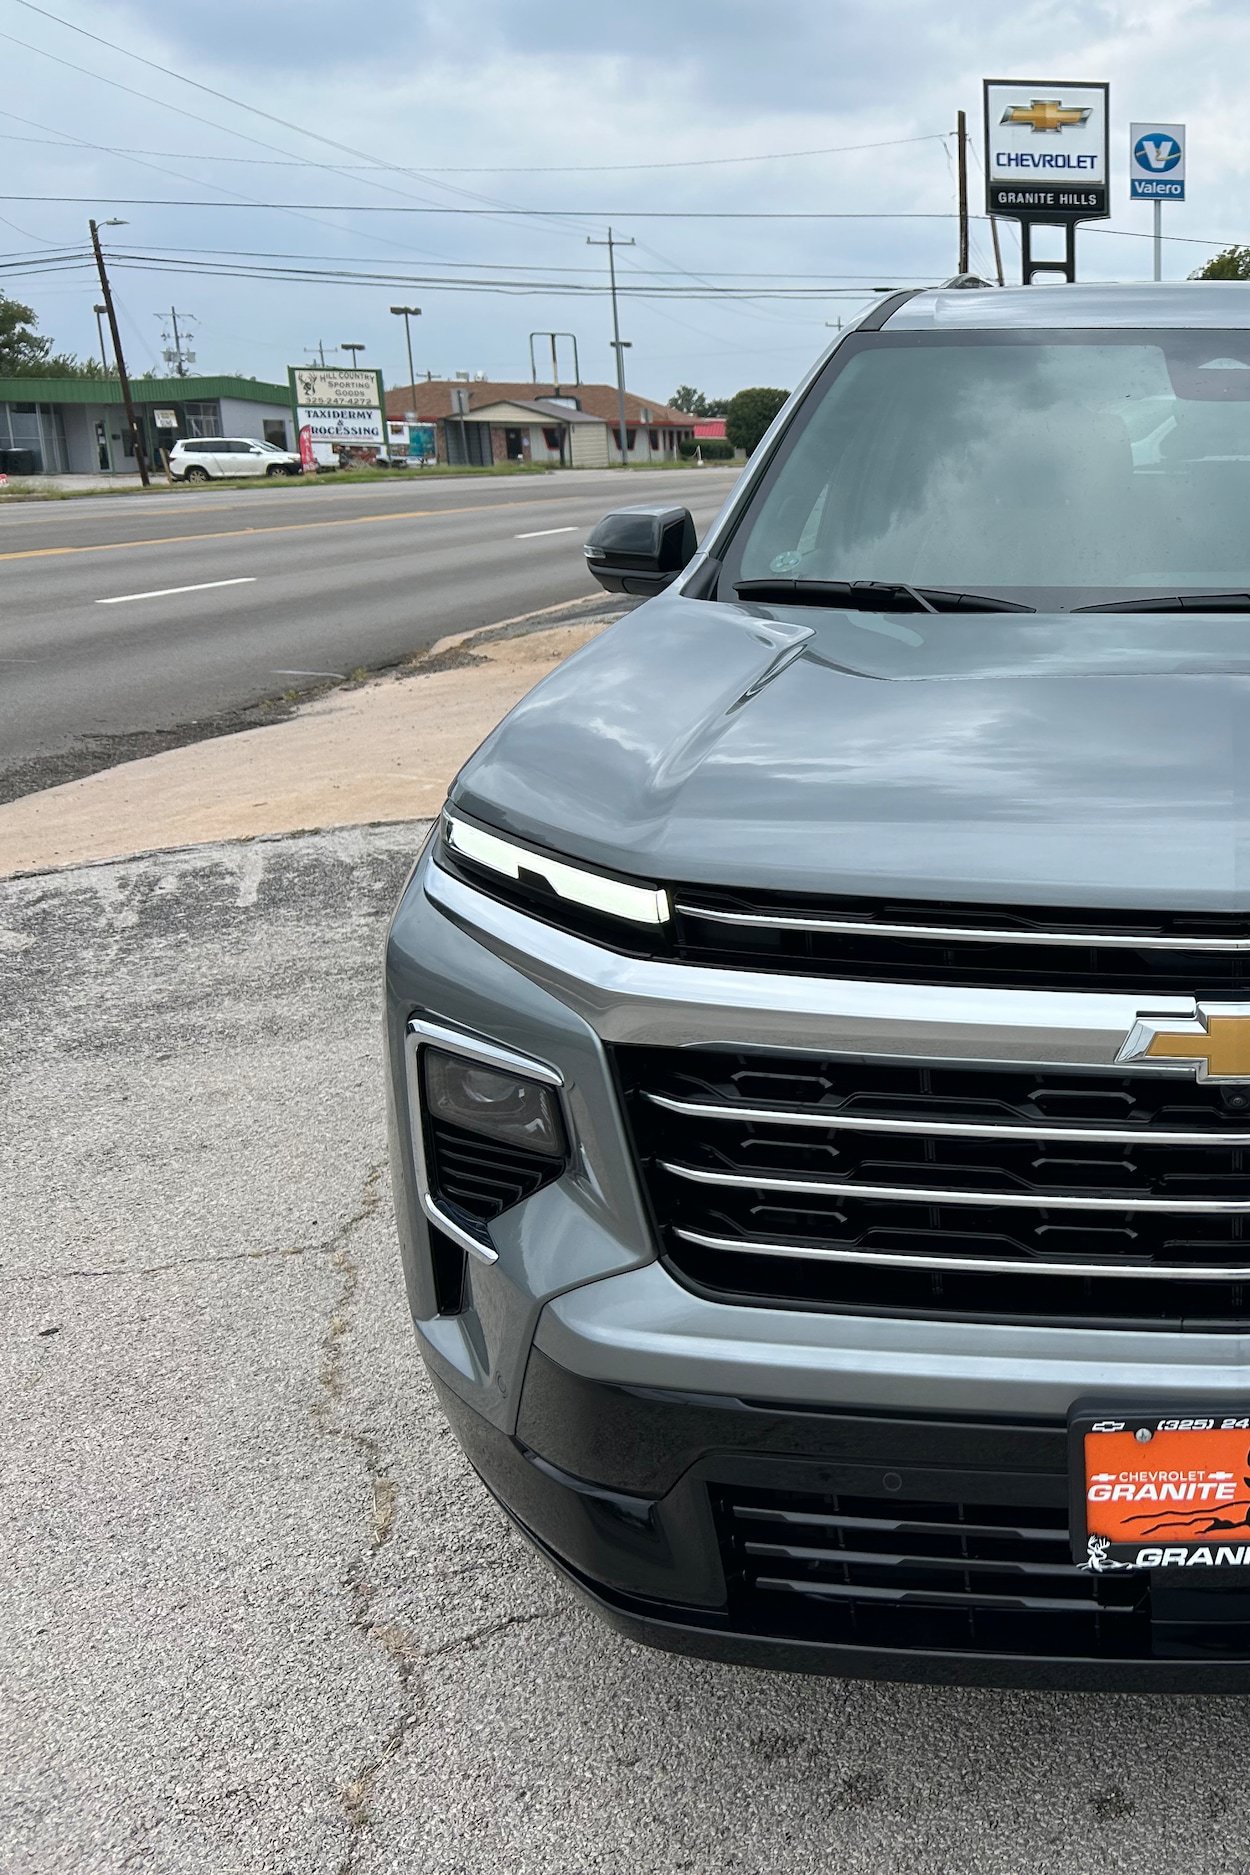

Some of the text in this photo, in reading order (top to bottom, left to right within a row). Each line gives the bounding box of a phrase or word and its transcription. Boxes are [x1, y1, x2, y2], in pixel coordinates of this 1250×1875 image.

[996, 152, 1098, 169] CHEVROLET
[1134, 181, 1182, 195] Valero
[998, 192, 1097, 206] GRANITE HILLS
[320, 371, 375, 383] HILL COUNTRY
[328, 380, 370, 389] SPORTING
[335, 389, 365, 397] GOODS
[305, 409, 374, 419] TAXIDERMY
[311, 425, 379, 436] ROCESSING
[1157, 1418, 1213, 1431] (325)
[1118, 1470, 1206, 1483] CHEVROLET
[1087, 1482, 1237, 1501] GRANITE
